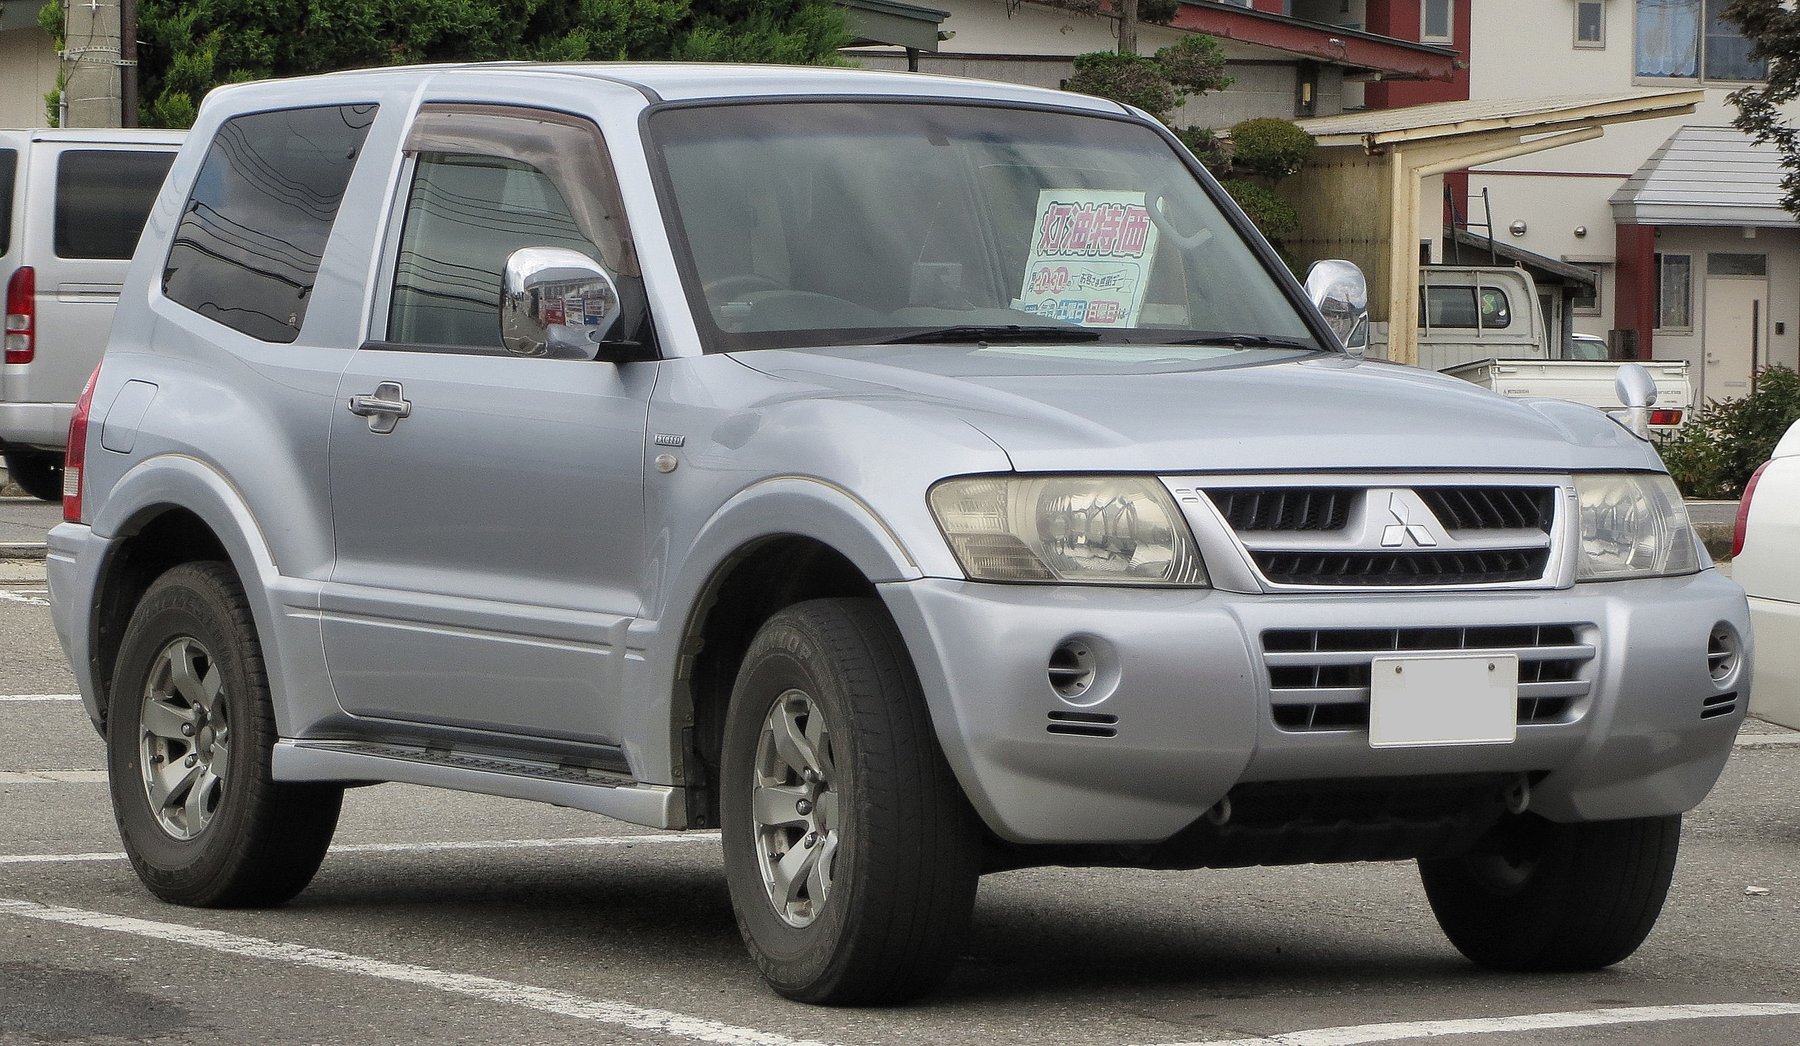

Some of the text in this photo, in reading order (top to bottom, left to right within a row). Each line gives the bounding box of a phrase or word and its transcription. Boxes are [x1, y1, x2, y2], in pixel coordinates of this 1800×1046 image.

[1037, 201, 1150, 257] 灯油特価
[655, 434, 681, 445] EXCEED
